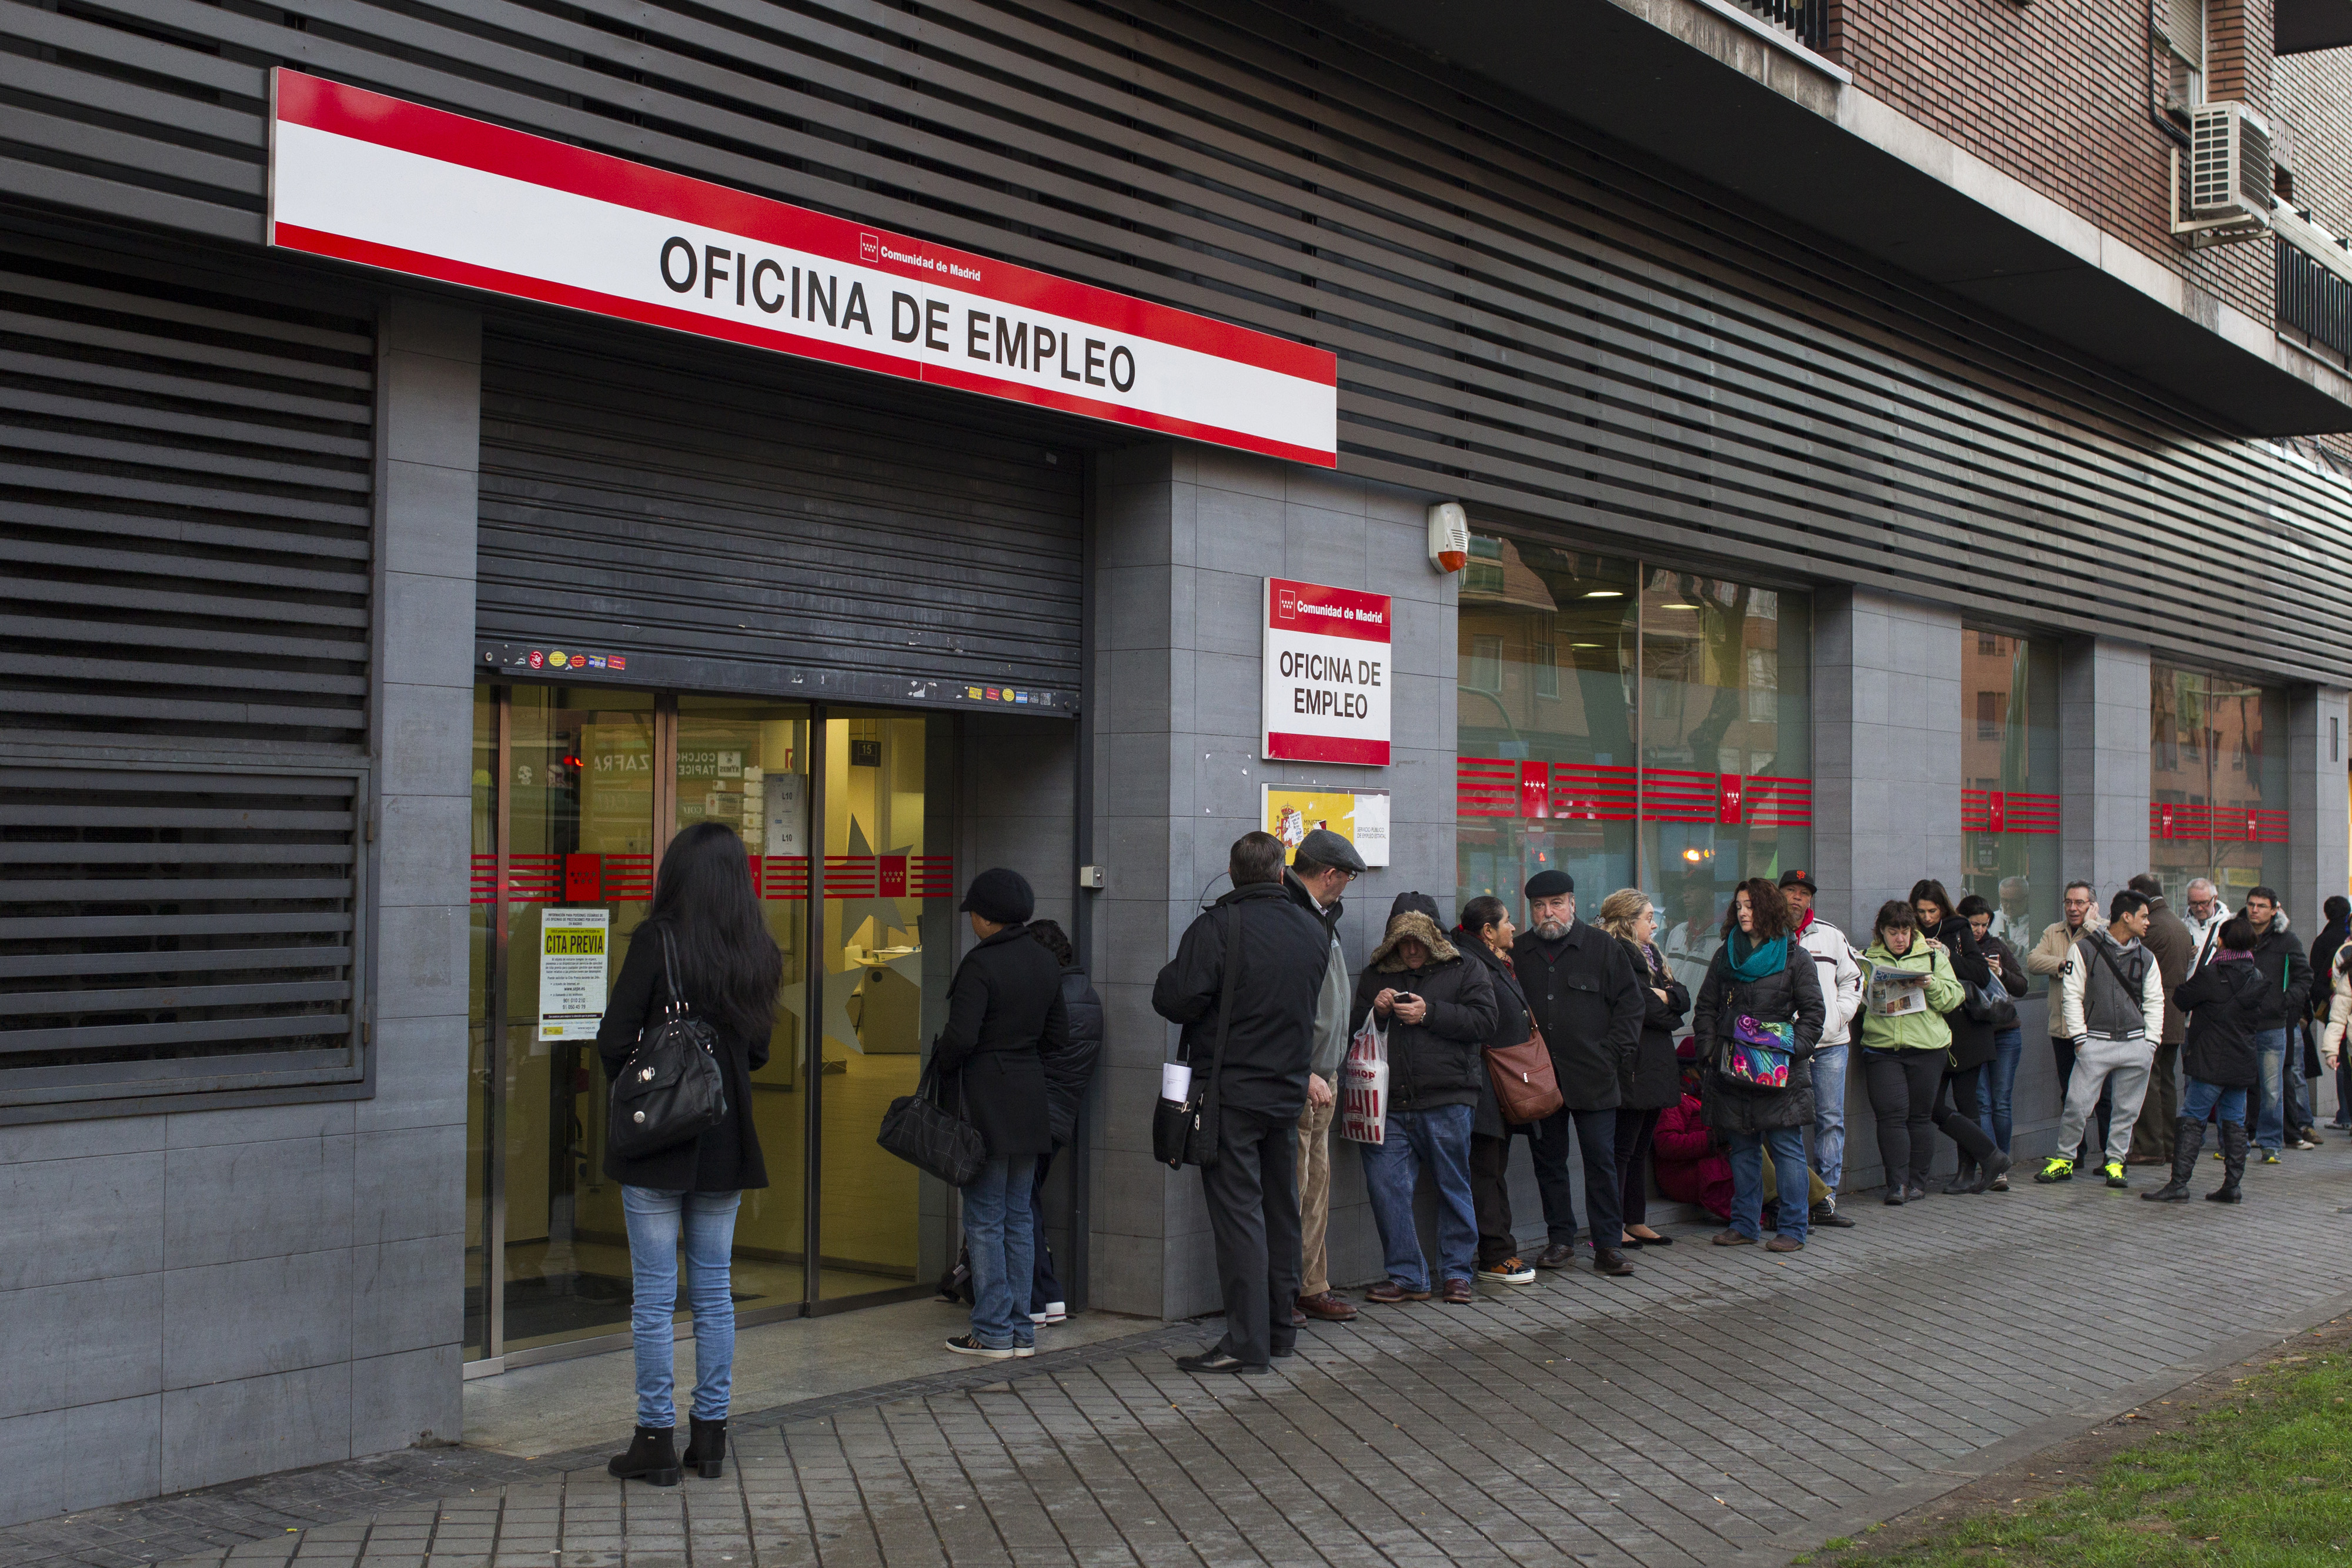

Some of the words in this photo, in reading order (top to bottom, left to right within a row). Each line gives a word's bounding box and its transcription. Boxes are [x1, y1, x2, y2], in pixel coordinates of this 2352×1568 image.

[881, 246, 934, 269] Comunidad
[936, 261, 947, 273] de
[950, 263, 981, 282] Madrid
[660, 236, 873, 336] OFICINA
[892, 290, 949, 353] DE
[968, 309, 1135, 393] EMPLEO
[1297, 600, 1342, 618] Comunidad
[1344, 607, 1354, 620] de
[1356, 609, 1382, 623] Madrid
[1280, 651, 1353, 684] OFICINA
[1359, 660, 1381, 687] DE
[1294, 687, 1368, 719] EMPLEO
[862, 744, 871, 754] 15
[546, 935, 567, 953] CITA
[570, 935, 603, 953] PREVIA
[2065, 961, 2073, 975] 9
